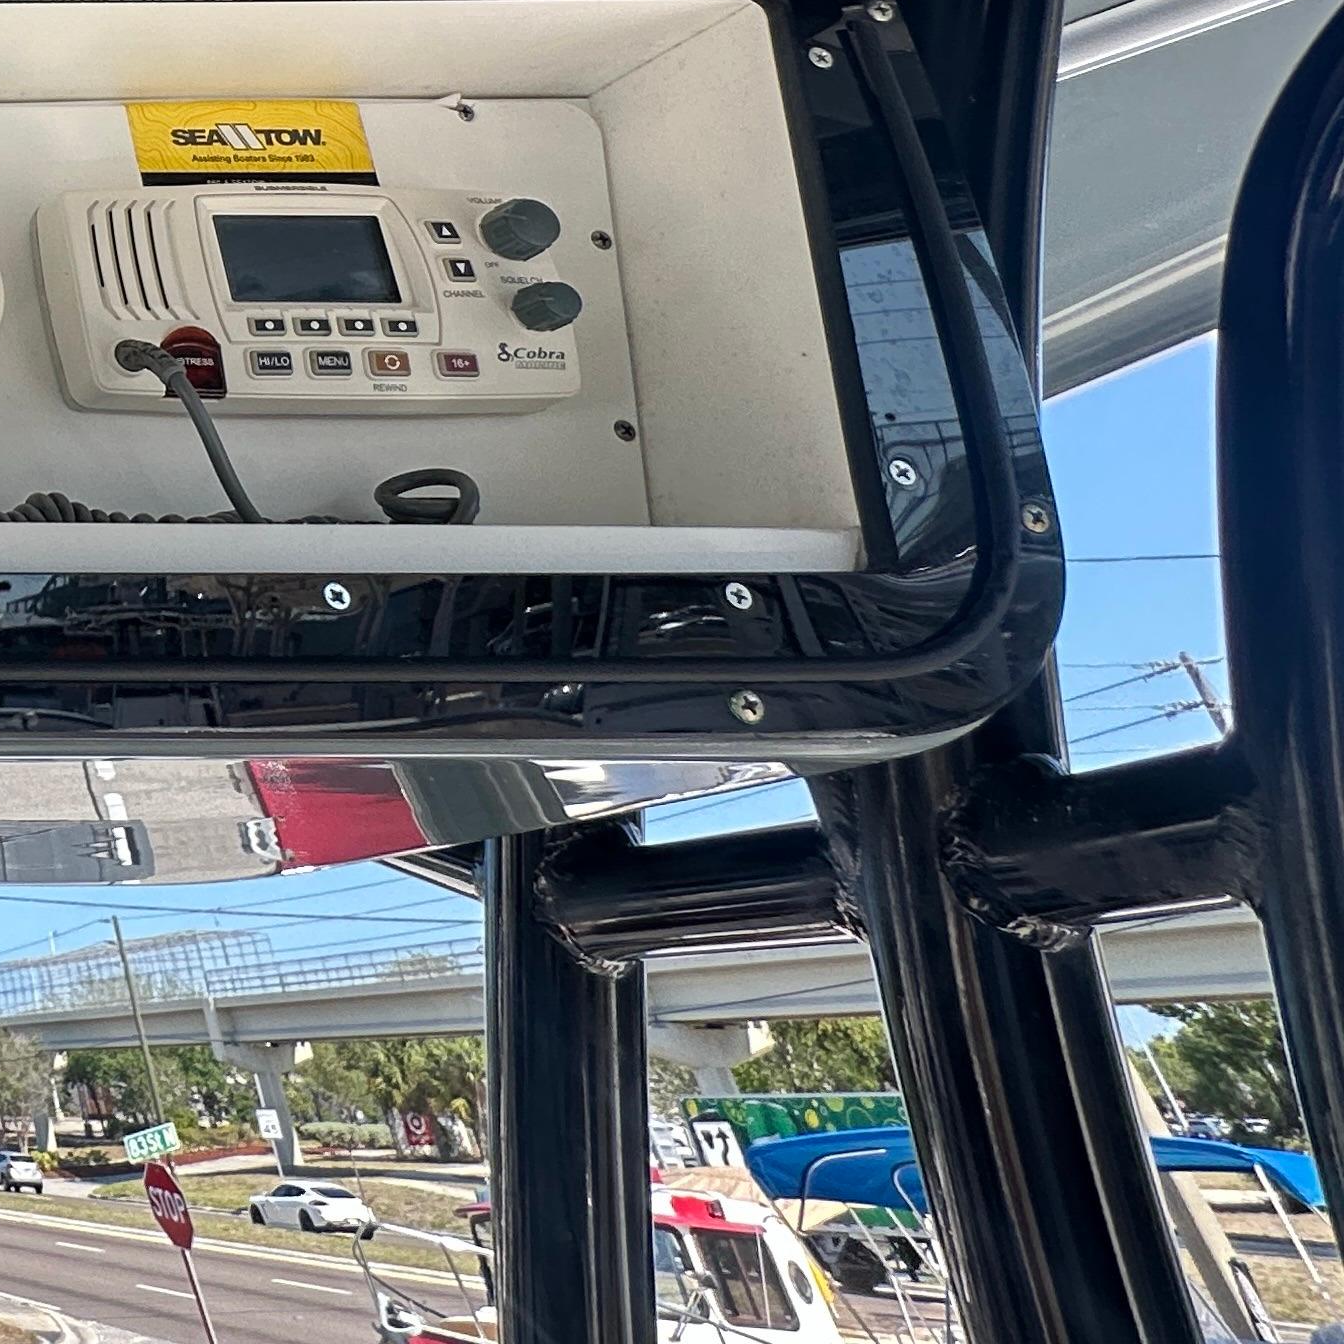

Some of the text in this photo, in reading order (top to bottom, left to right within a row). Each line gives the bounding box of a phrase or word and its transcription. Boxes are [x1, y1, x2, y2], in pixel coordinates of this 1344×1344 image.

[170, 128, 322, 147] SEA TOW
[268, 154, 293, 163] Since
[443, 290, 486, 299] CHANNEL
[513, 346, 565, 360] Cobra
[258, 355, 290, 367] HI/LO
[318, 355, 349, 367] MENU
[451, 358, 471, 368] 16+
[373, 383, 408, 393] REWIND
[149, 1185, 186, 1223] STOP
